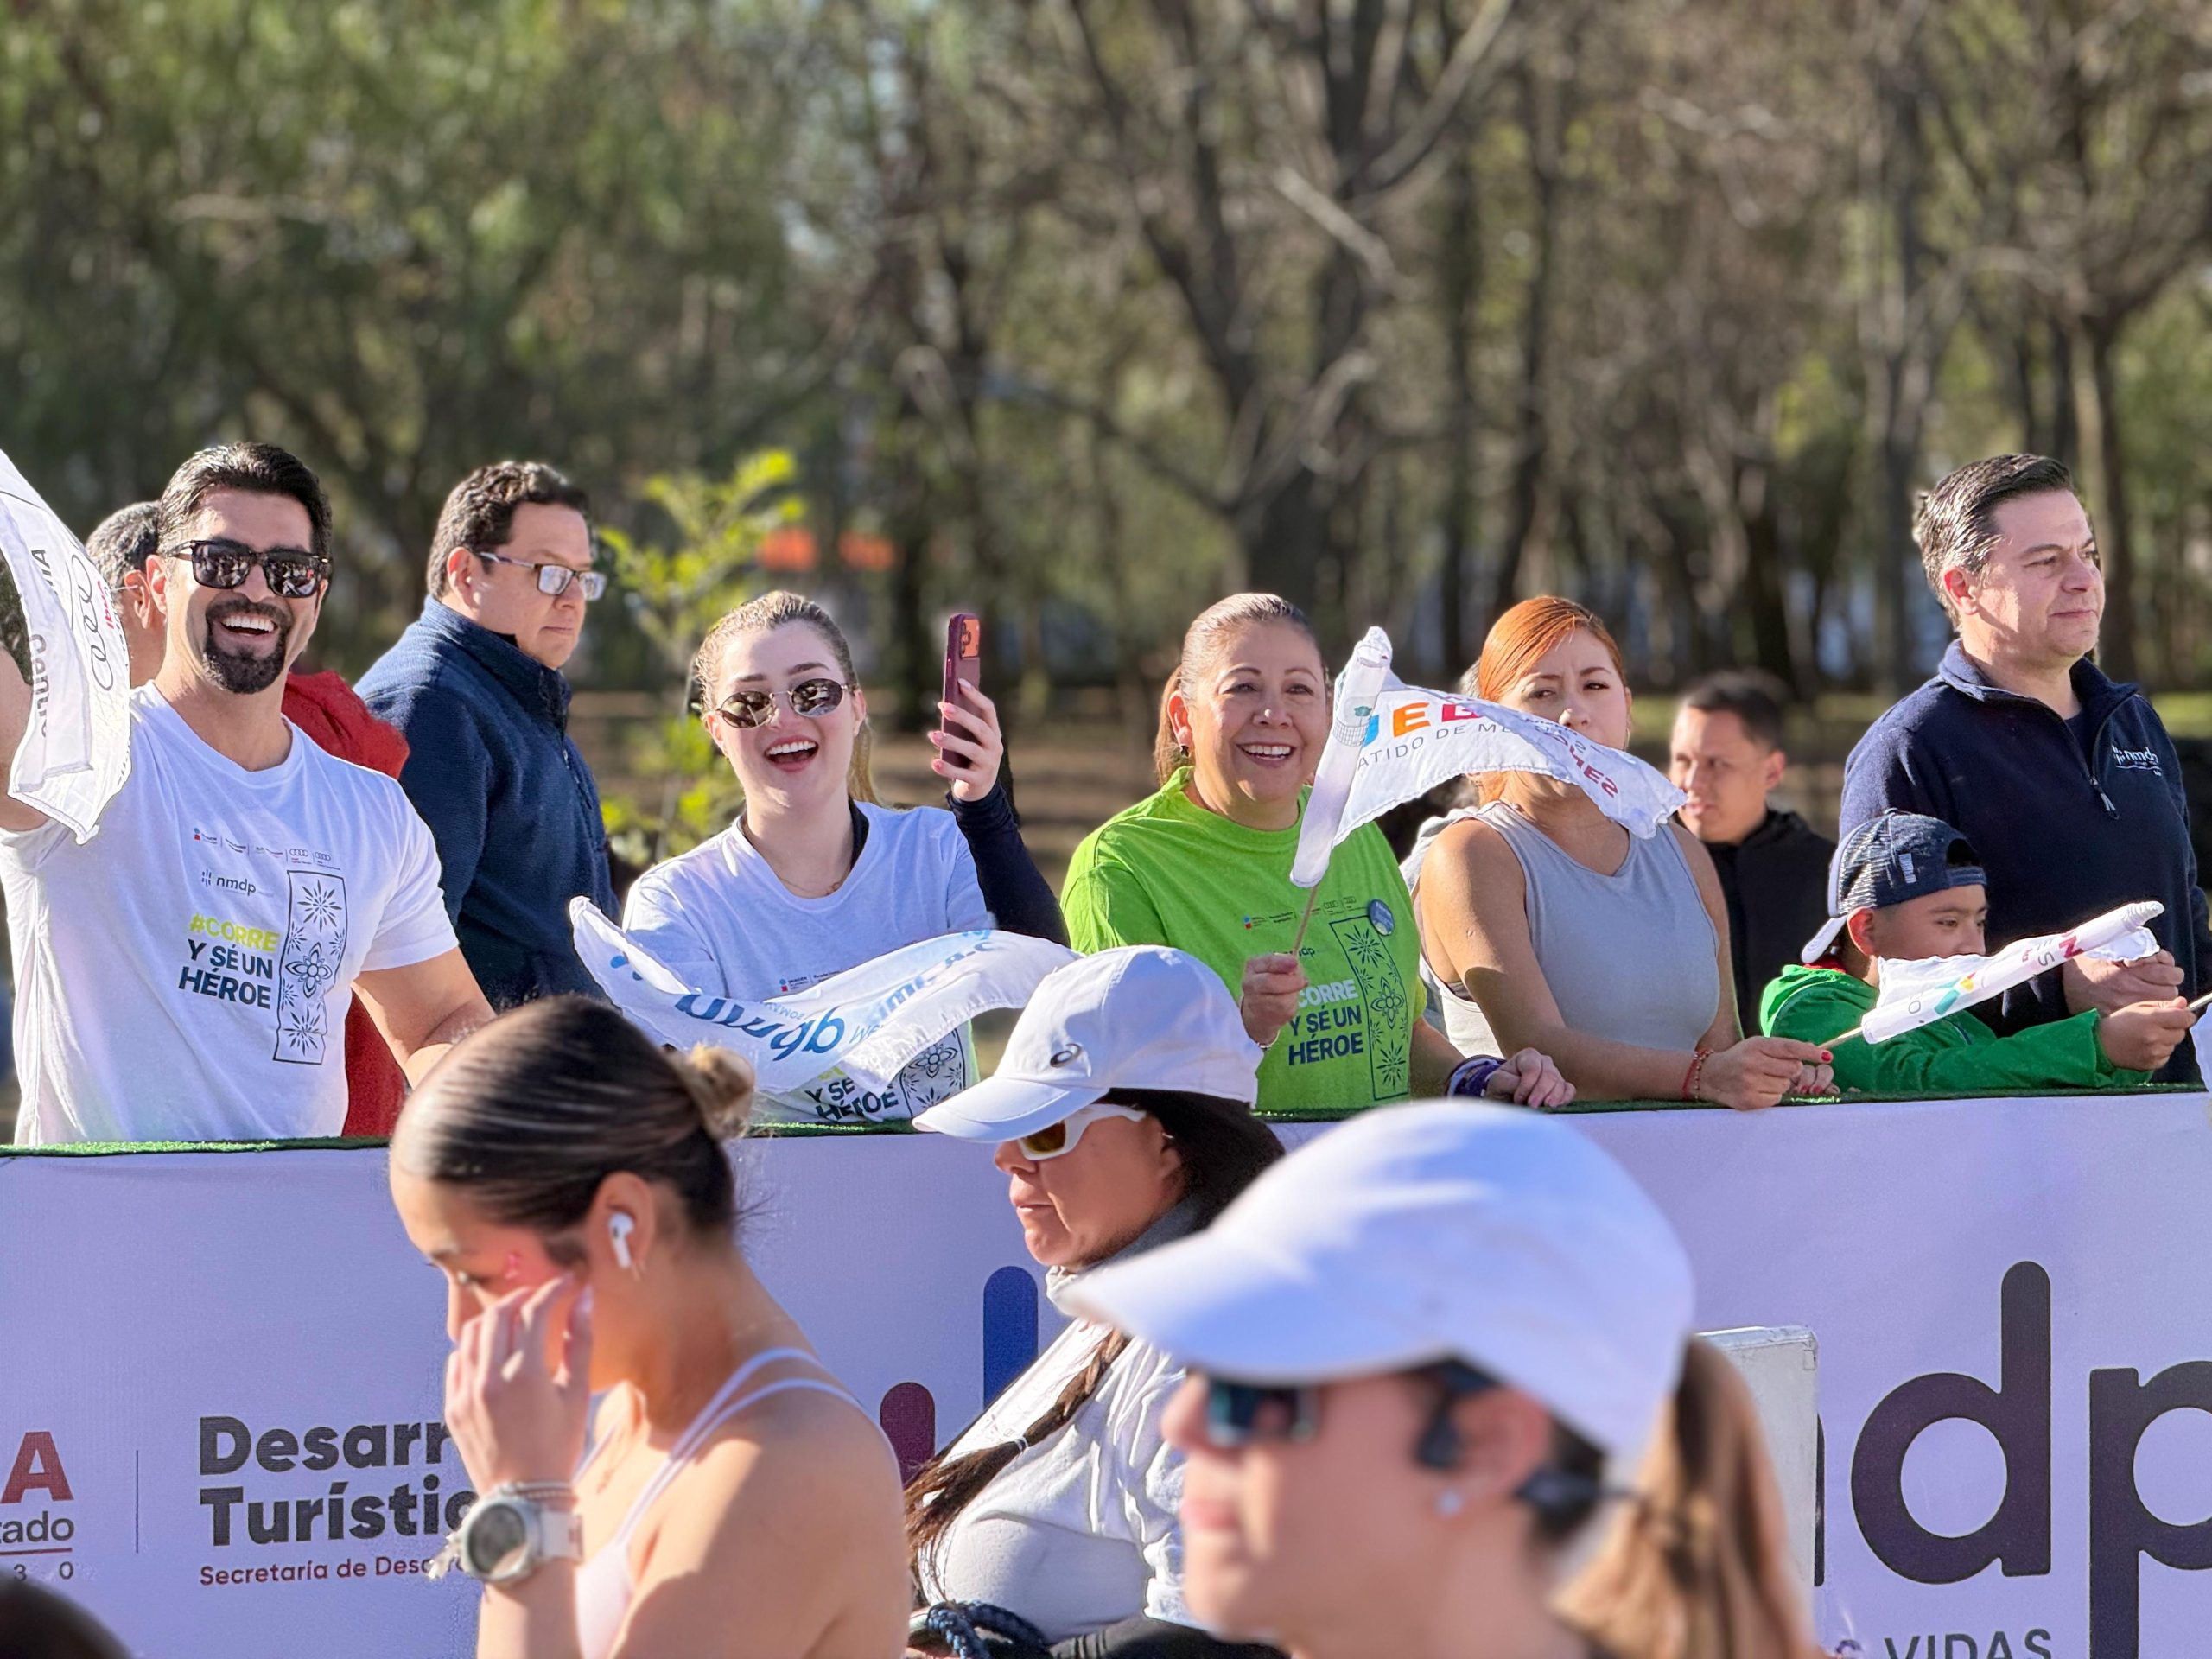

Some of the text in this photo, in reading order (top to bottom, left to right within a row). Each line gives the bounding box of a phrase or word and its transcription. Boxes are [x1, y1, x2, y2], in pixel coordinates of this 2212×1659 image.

[1436, 724, 1466, 740] DE
[216, 875, 257, 897] nmdp
[189, 912, 281, 952] #CORRE
[188, 938, 273, 980] Y SÉ UN
[178, 966, 271, 1009] HÉROE
[1288, 1004, 1363, 1037] Y SÉ UN
[1288, 1032, 1364, 1066] HÉROE
[1815, 1261, 2212, 1659] dp
[200, 1560, 328, 1586] Secretaría
[336, 1558, 367, 1578] de
